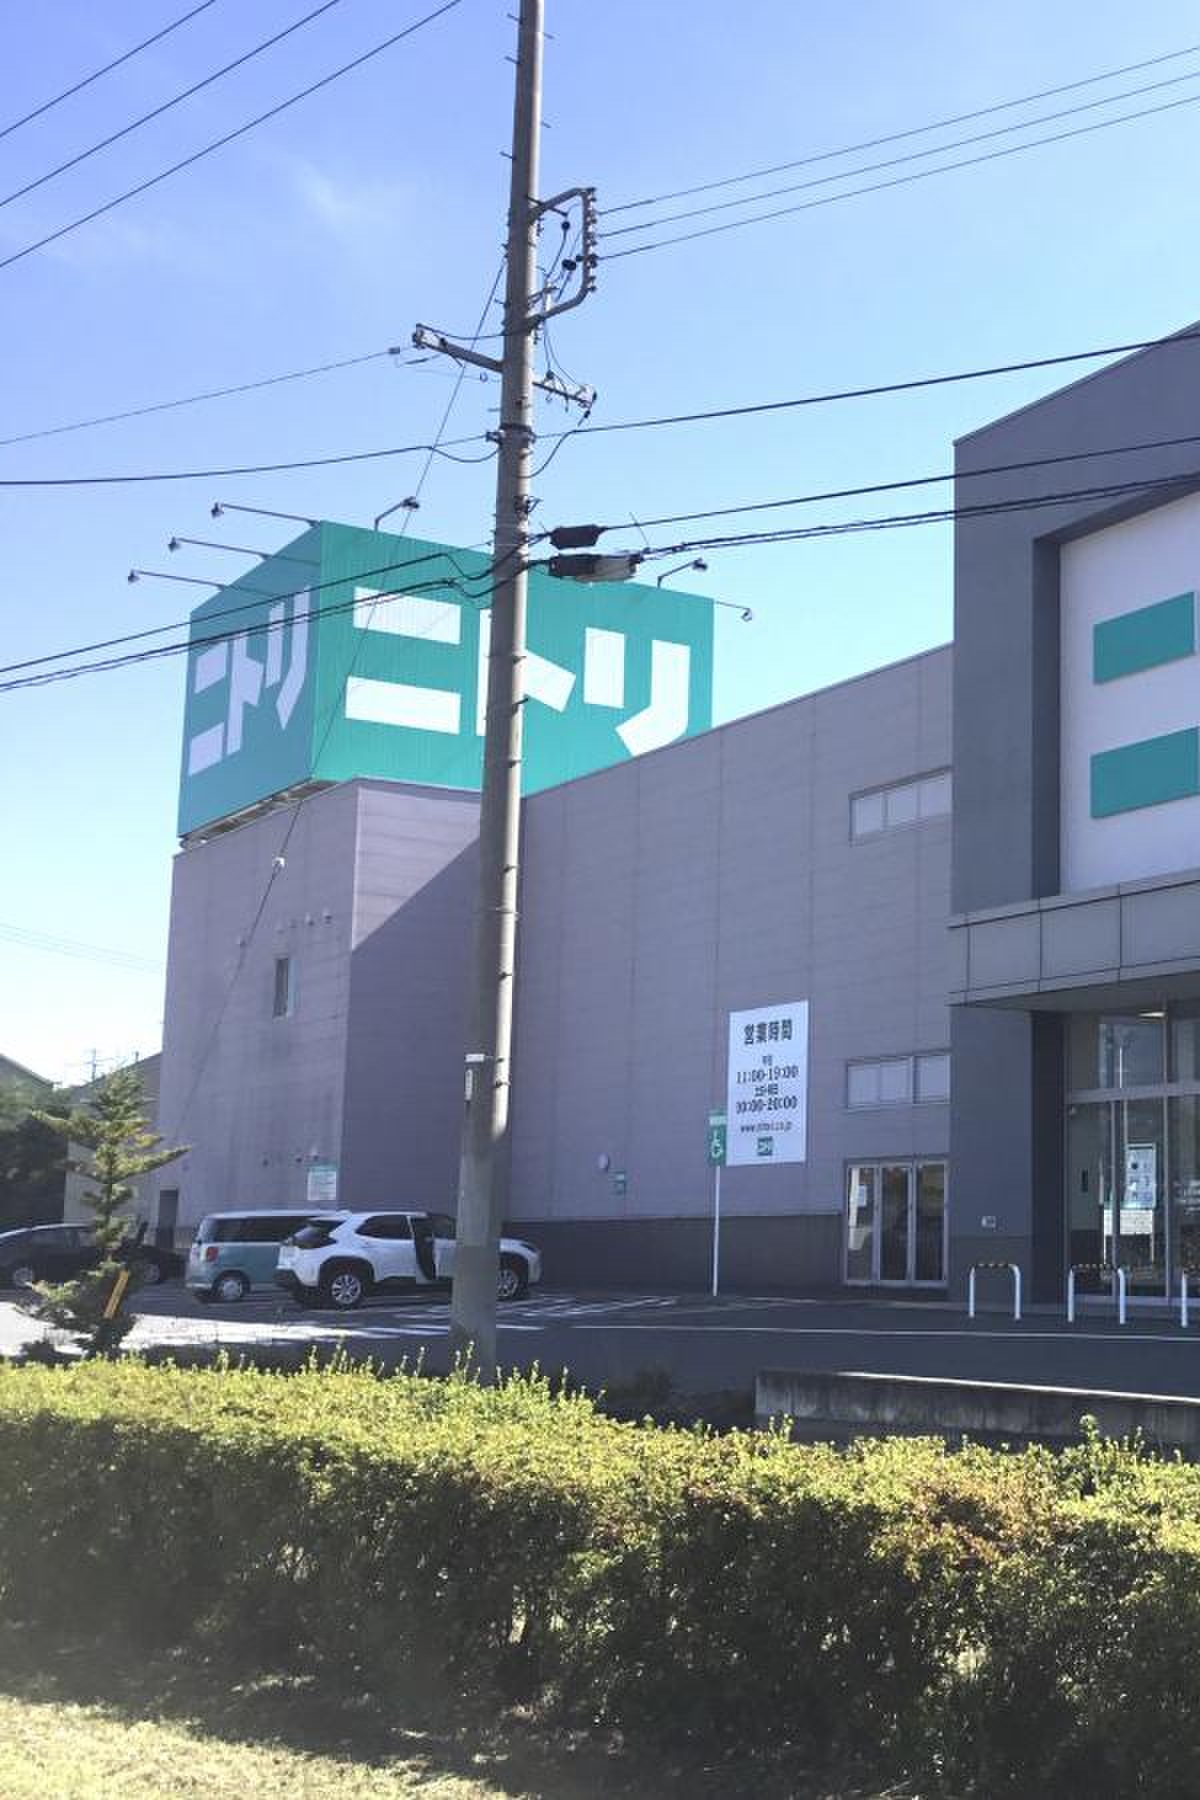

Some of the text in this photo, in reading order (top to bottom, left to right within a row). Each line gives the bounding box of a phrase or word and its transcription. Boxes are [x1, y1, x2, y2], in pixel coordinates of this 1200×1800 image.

[188, 586, 310, 776] ニトリ
[744, 1019, 792, 1045] 営業時間
